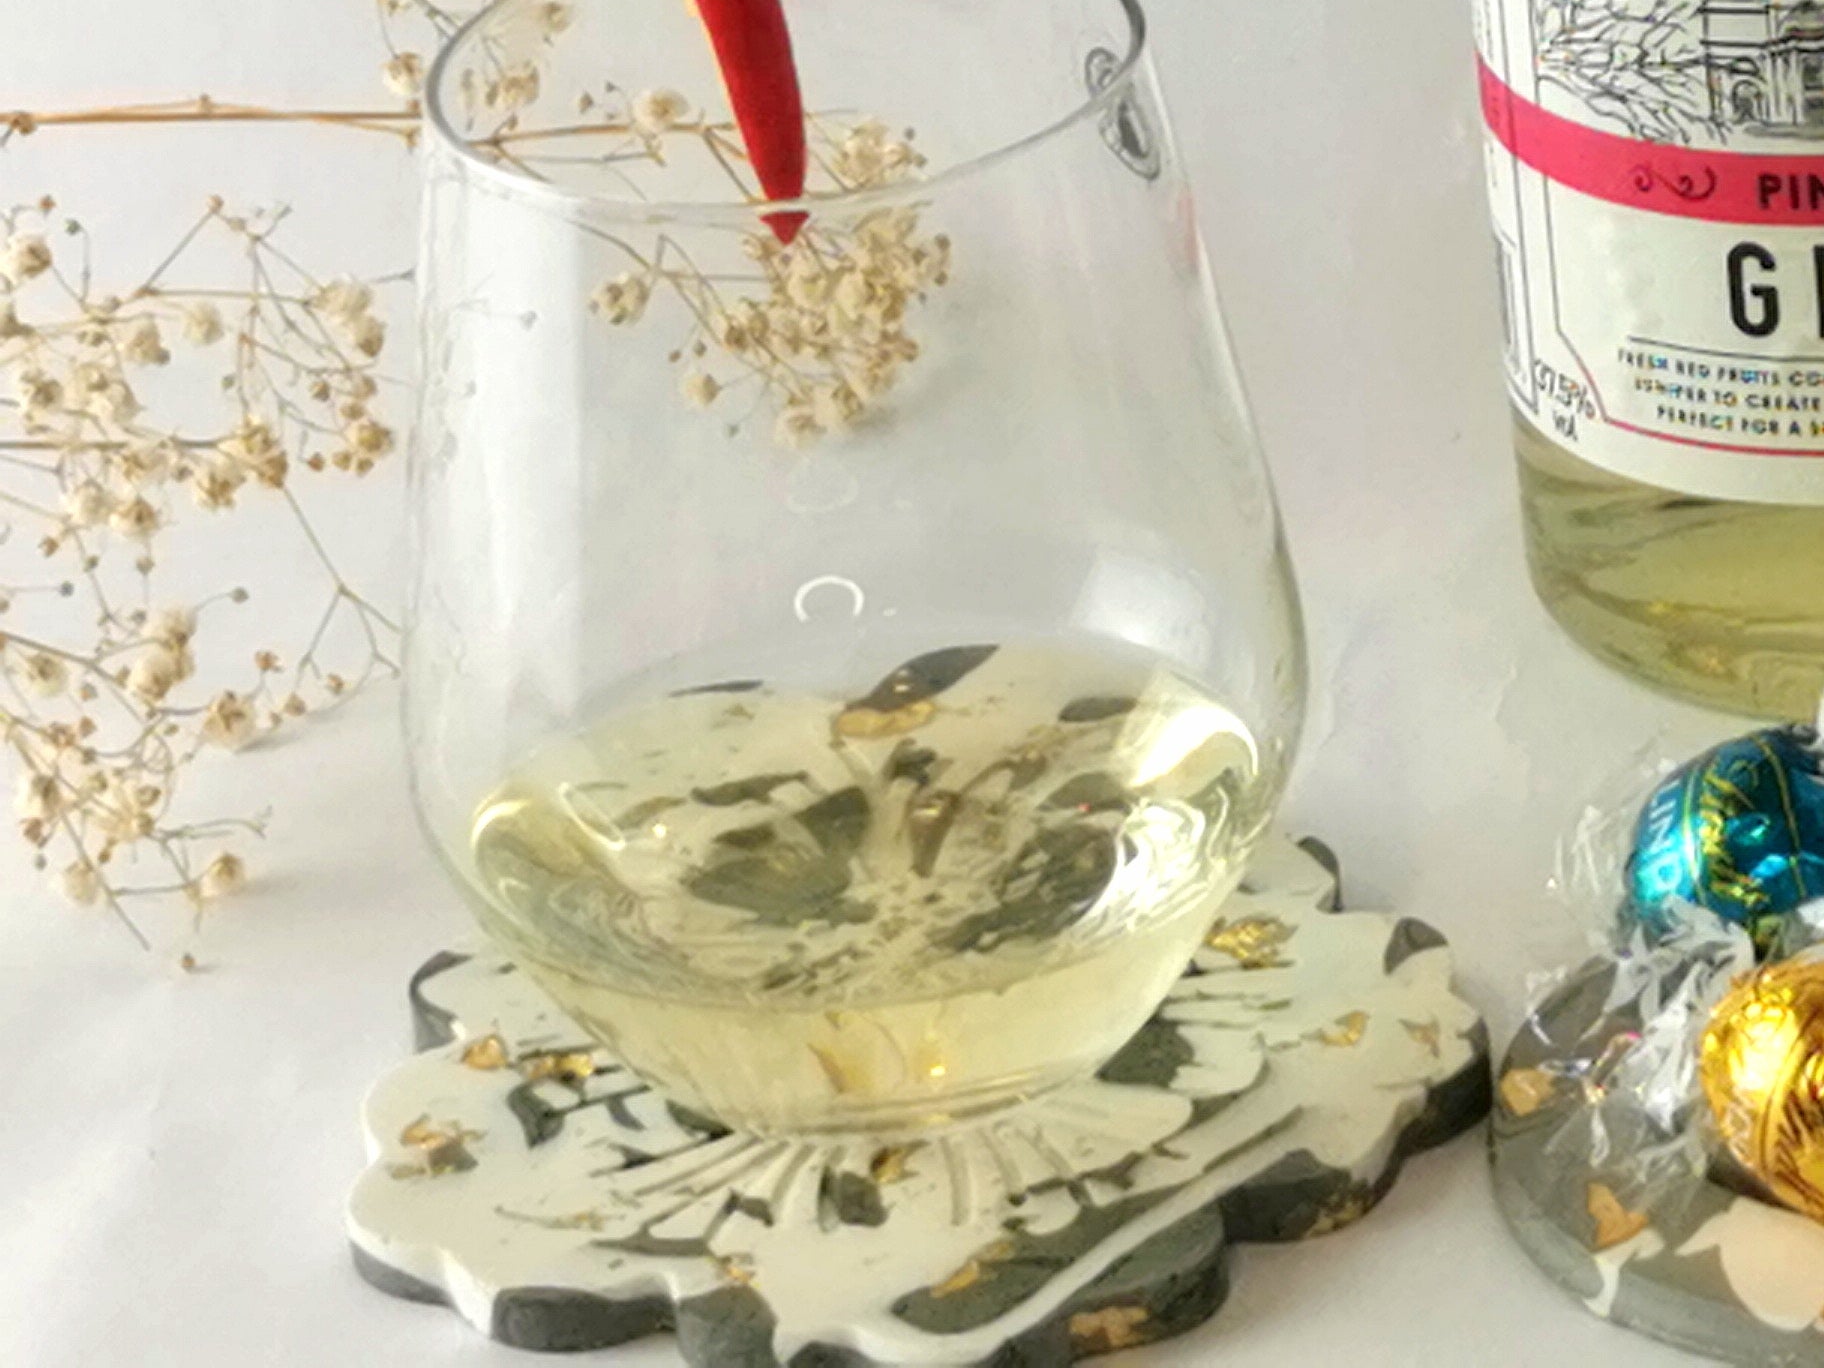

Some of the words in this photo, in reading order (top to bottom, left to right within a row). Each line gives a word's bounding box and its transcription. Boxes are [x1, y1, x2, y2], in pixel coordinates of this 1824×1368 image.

[1713, 390, 1738, 407] TO
[1741, 417, 1778, 436] FOR
[1788, 421, 1801, 436] A
